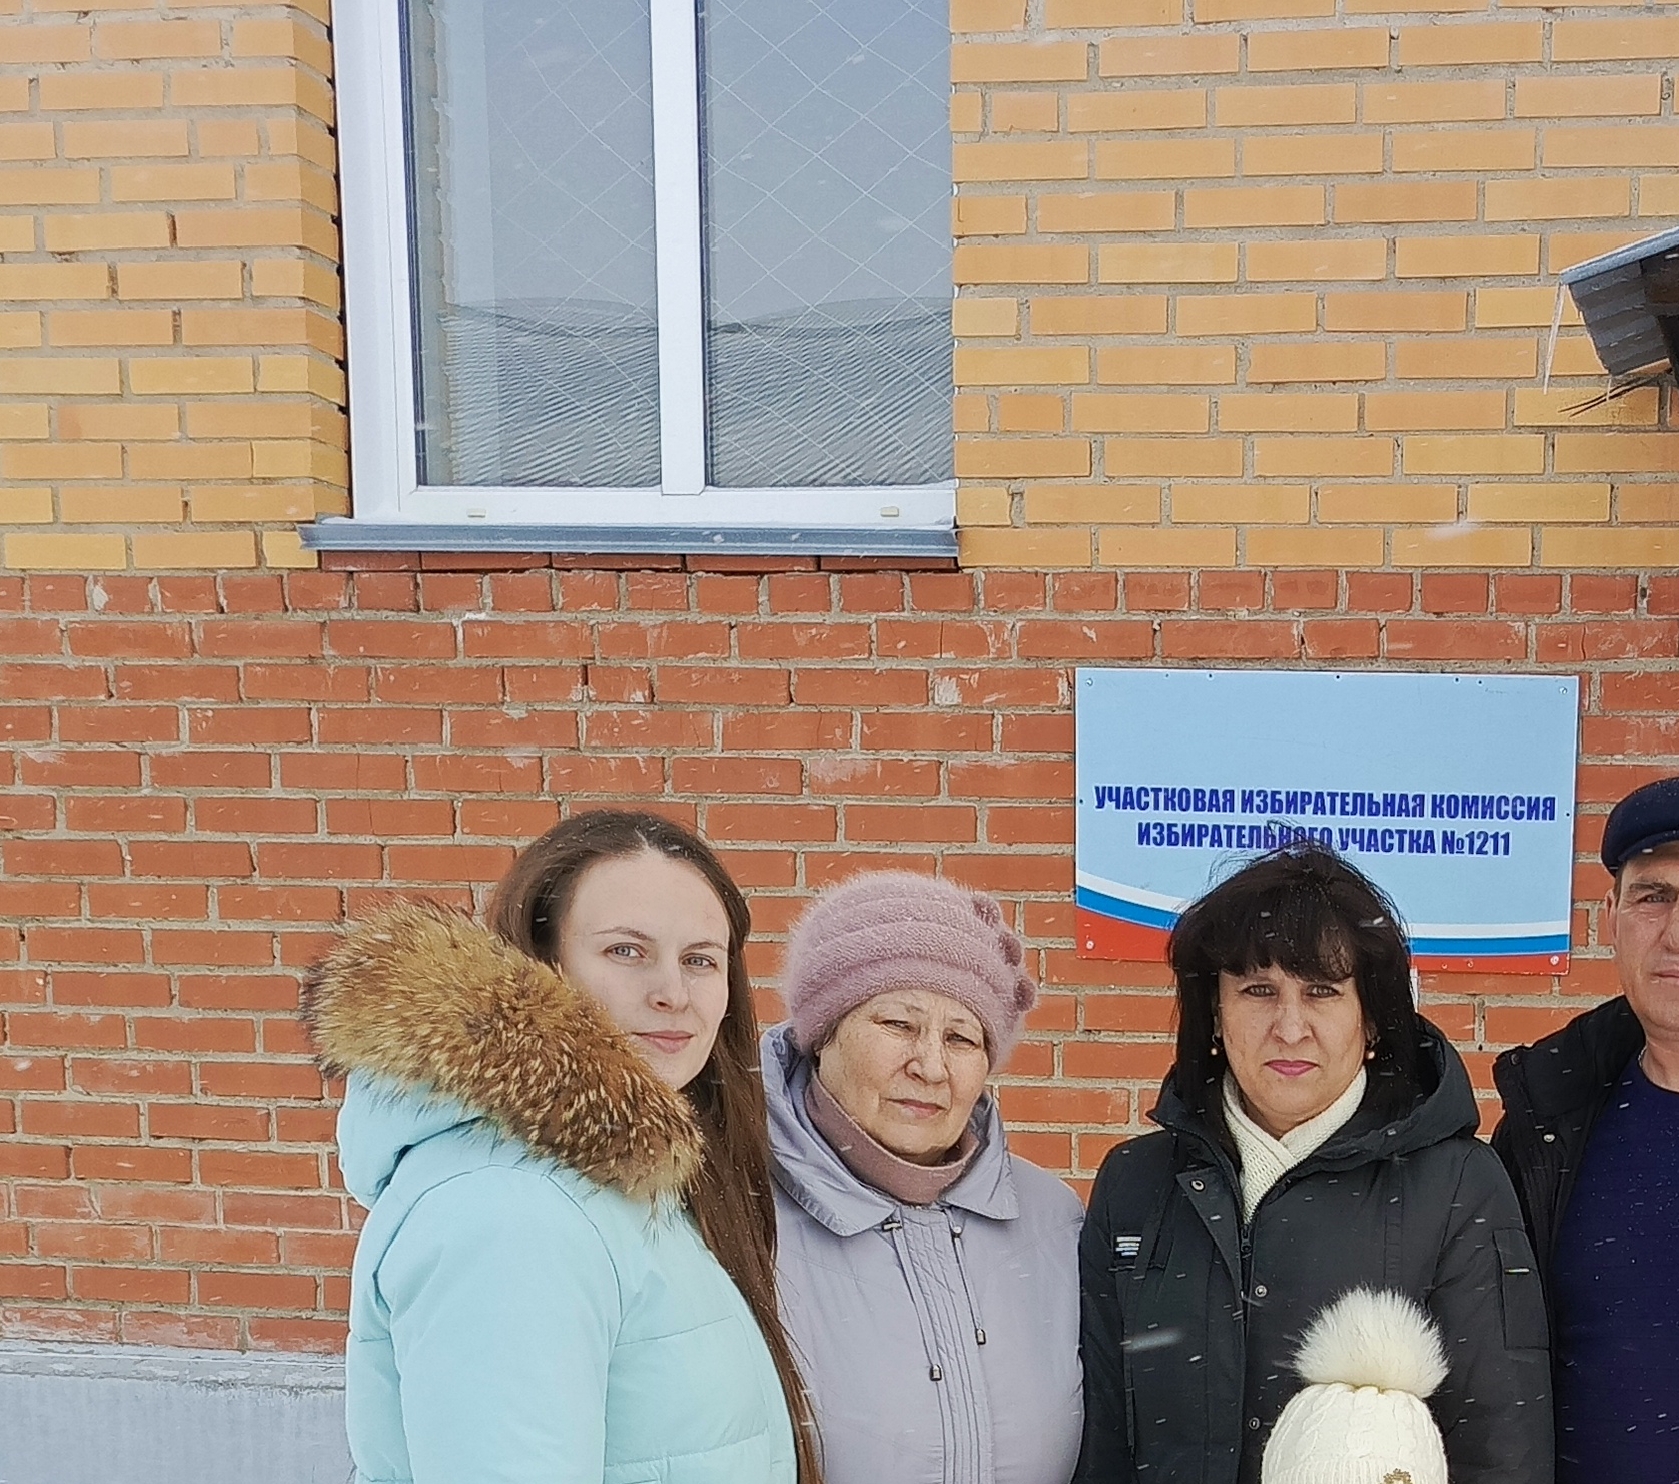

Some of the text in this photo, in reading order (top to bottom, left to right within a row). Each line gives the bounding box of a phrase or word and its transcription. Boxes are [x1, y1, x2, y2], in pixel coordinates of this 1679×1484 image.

[1094, 786, 1556, 821] УЧАСТКОВАЯ ИЗБИРАТЕЛЬНАЯ КОМИССИЯ
[1339, 827, 1436, 854] УЧАСТКА
[1442, 830, 1511, 856] №1211
